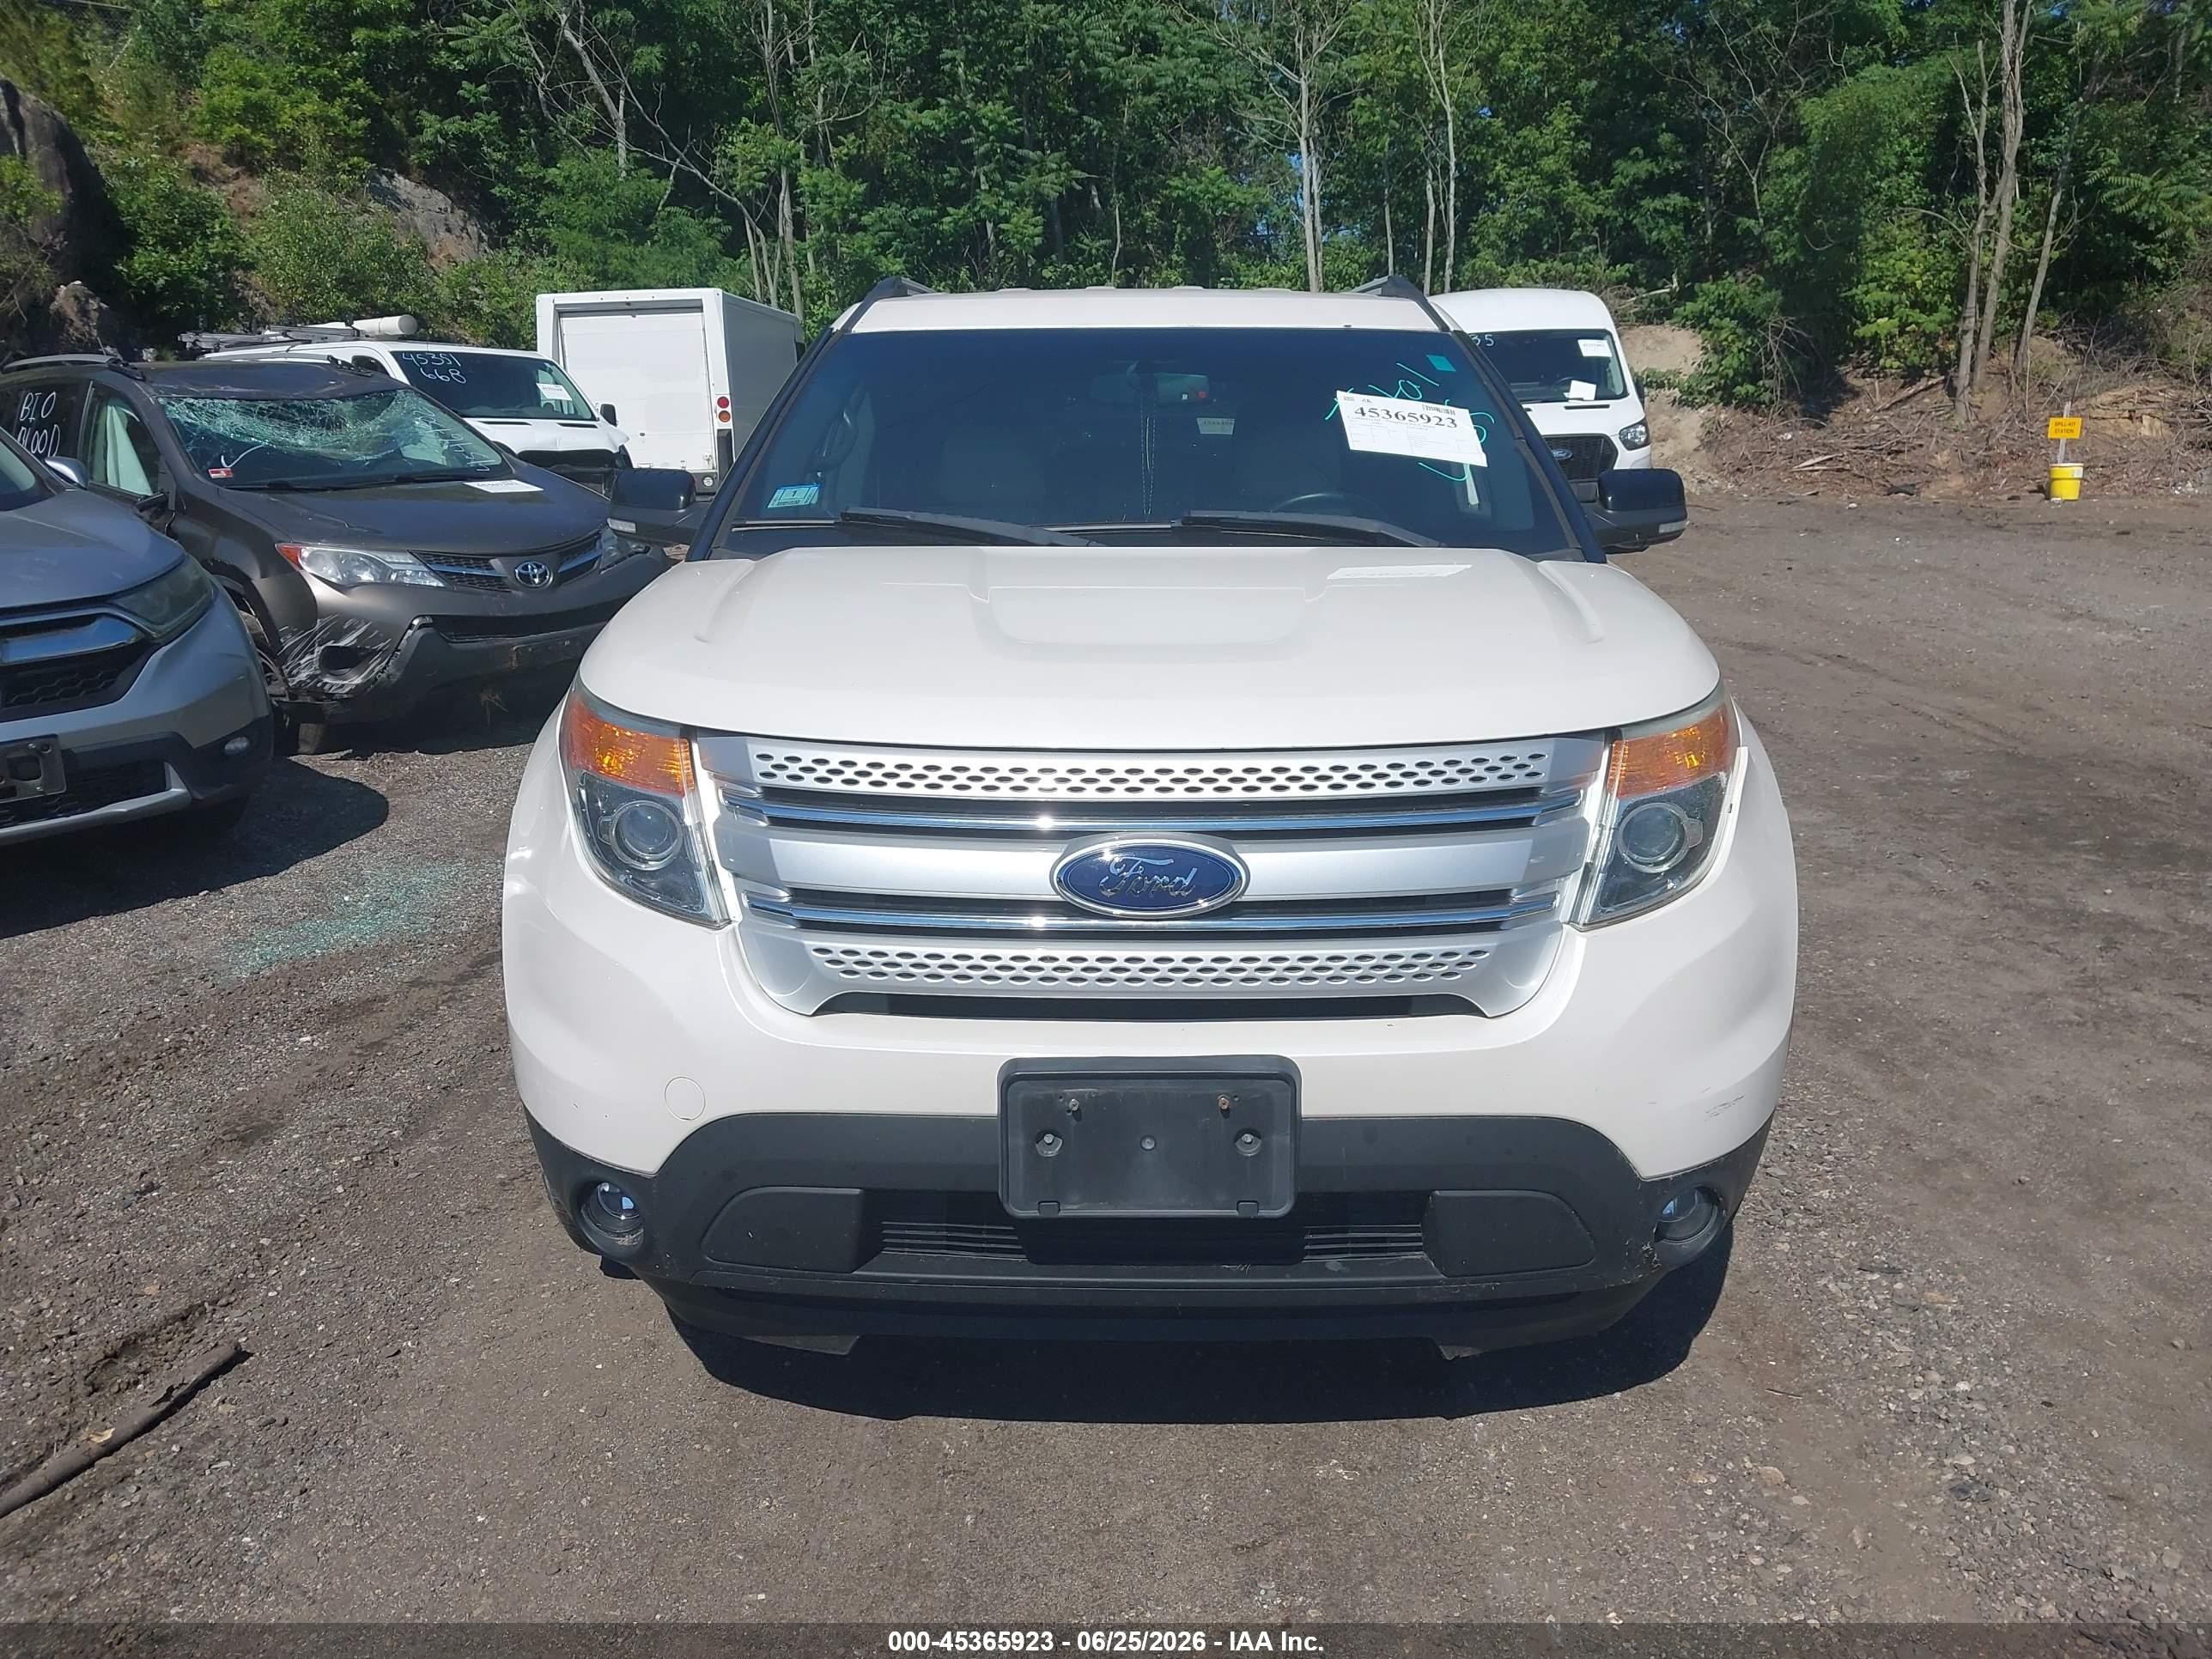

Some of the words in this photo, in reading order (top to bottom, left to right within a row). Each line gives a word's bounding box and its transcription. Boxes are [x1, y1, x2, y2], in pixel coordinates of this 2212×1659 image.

[402, 352, 462, 367] 45351
[421, 367, 467, 384] 668
[20, 391, 57, 423] BIO
[1354, 406, 1457, 428] 45365923
[1099, 855, 1198, 898] Ford
